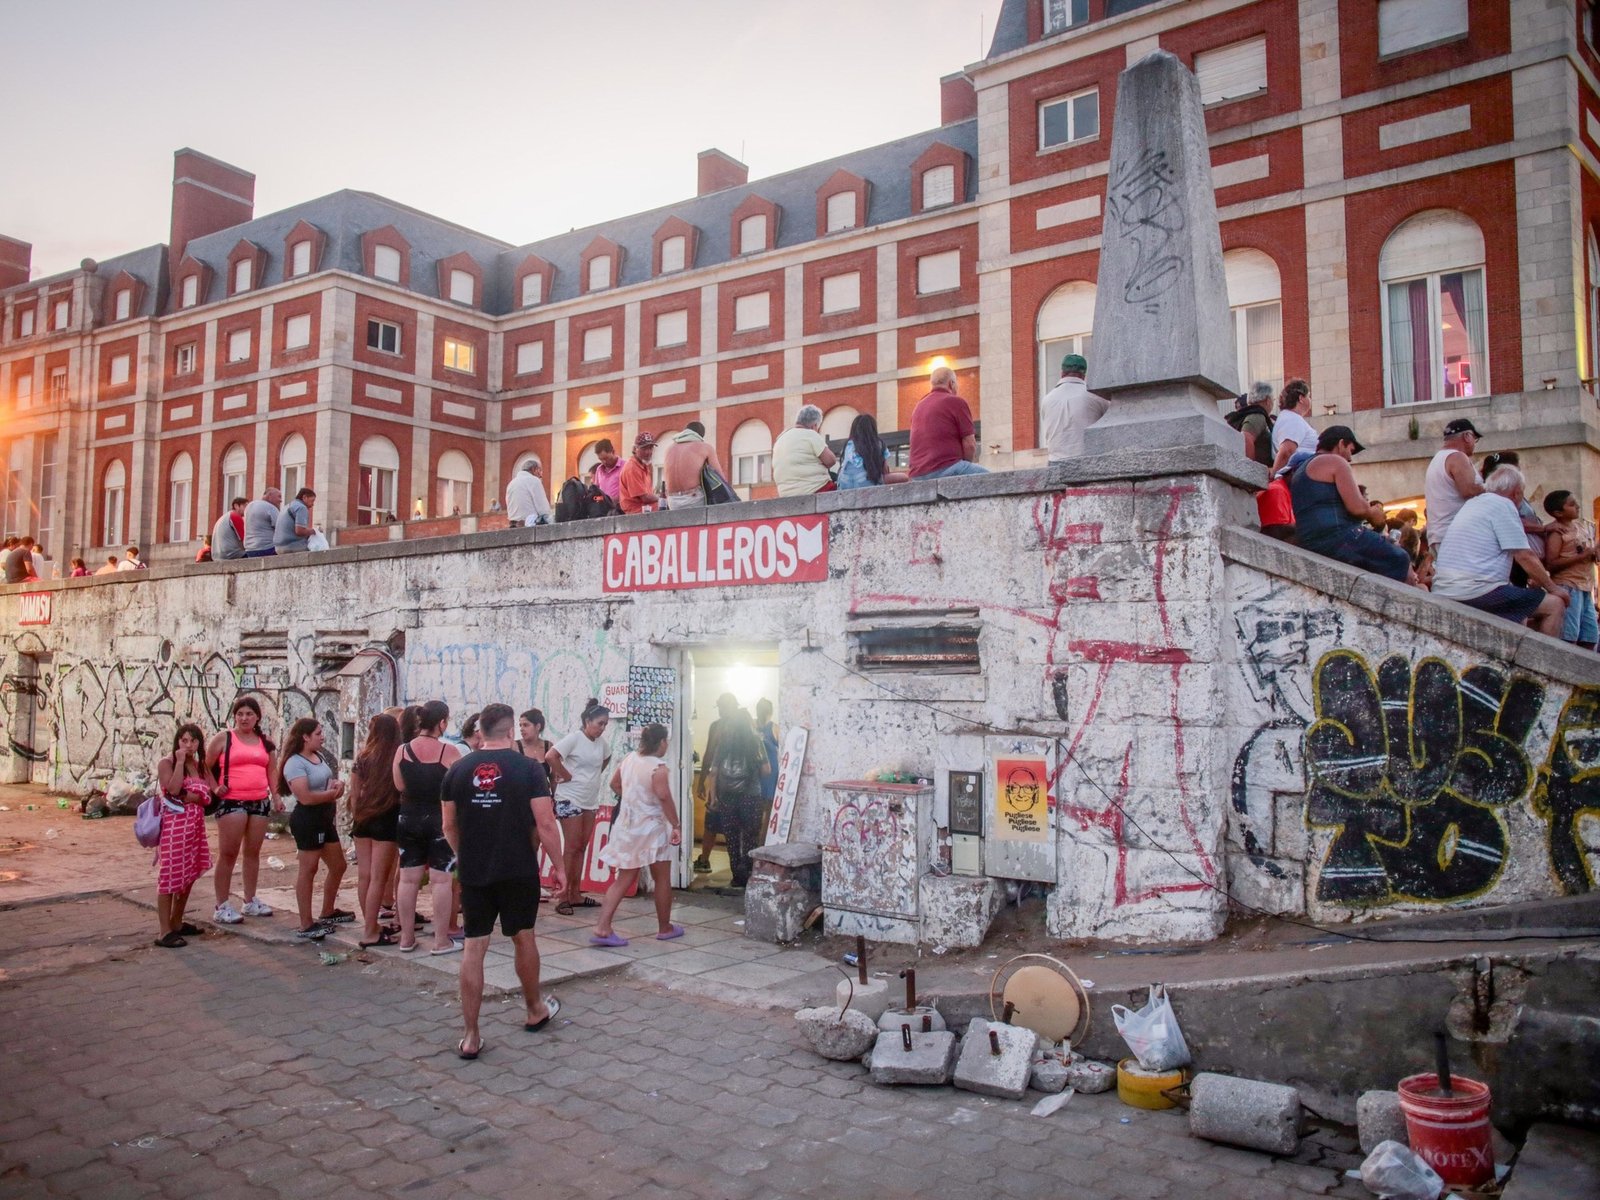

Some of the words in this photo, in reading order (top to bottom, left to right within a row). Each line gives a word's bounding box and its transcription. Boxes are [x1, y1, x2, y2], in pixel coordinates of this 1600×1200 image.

[606, 520, 798, 589] CABALLEROS
[20, 594, 46, 622] DAMAS
[770, 751, 789, 835] AGUA
[1005, 811, 1034, 820] Pugliese
[1008, 818, 1037, 827] Pugliese
[1012, 824, 1041, 833] Pugliese
